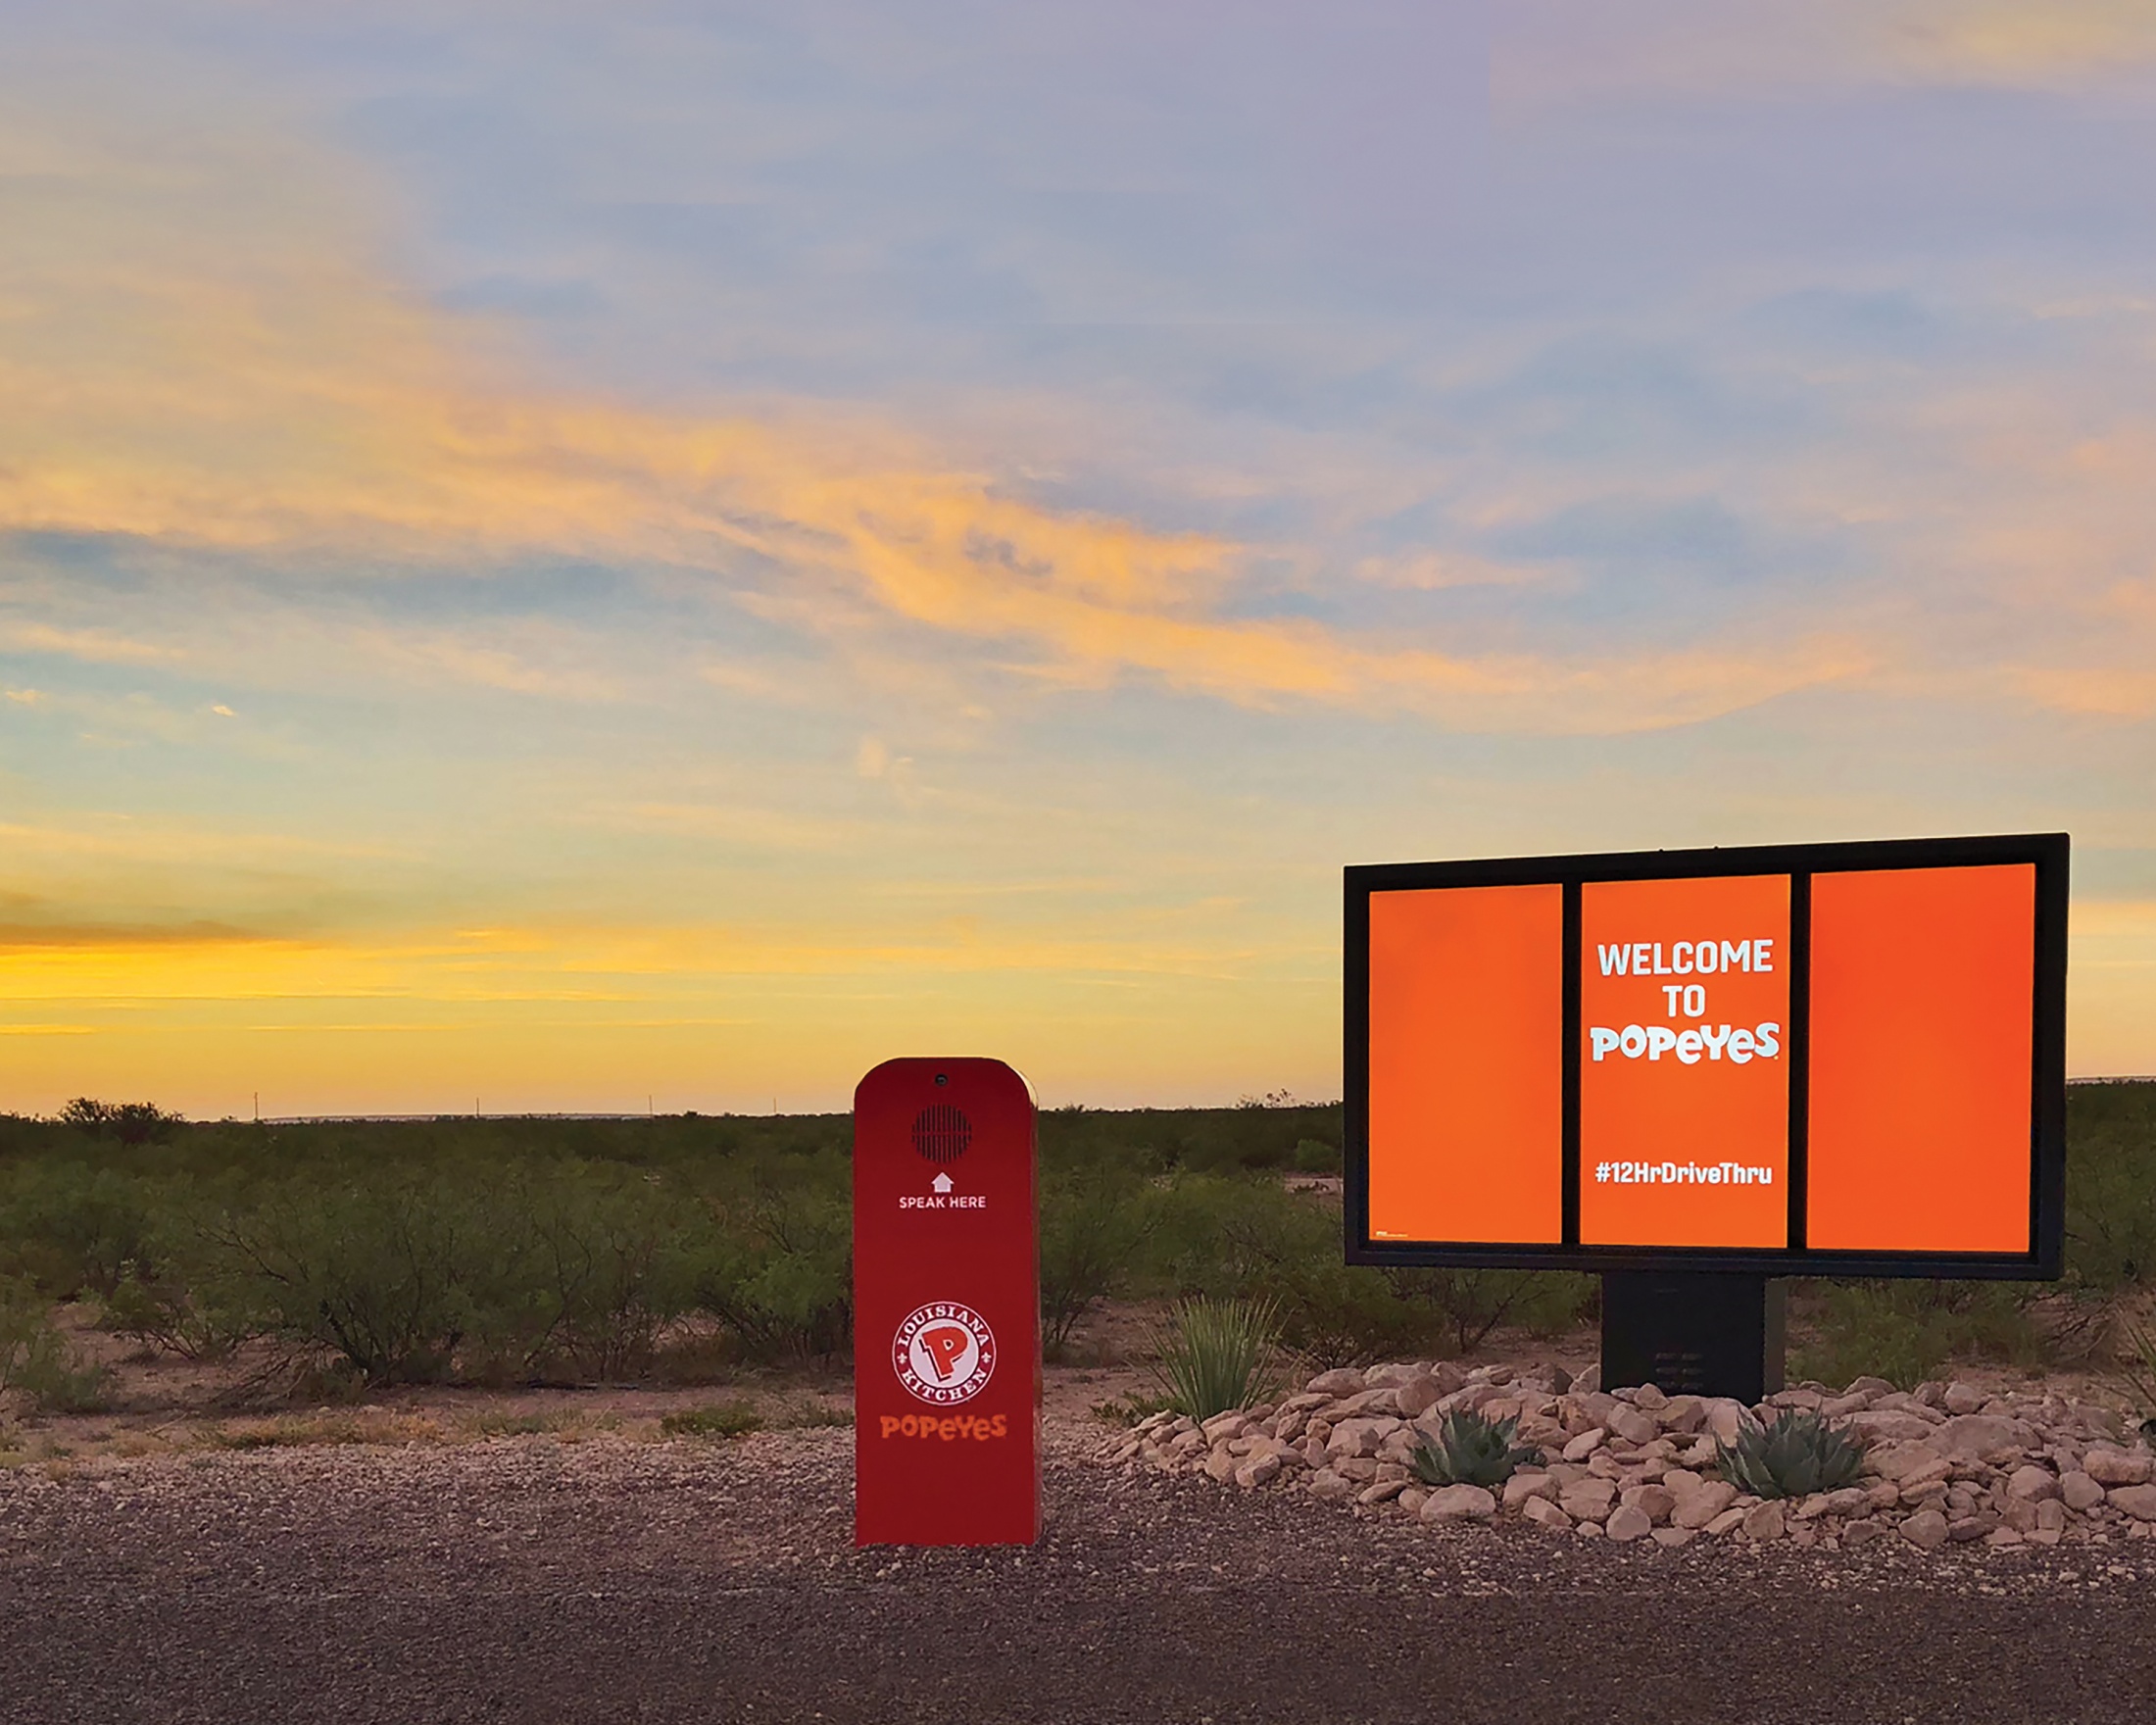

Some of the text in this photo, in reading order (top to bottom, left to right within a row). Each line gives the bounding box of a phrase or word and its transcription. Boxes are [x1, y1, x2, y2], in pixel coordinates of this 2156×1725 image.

[1597, 938, 1774, 976] WELCOME
[1662, 984, 1706, 1018] TO
[1594, 1160, 1773, 1185] #12HrDriveThru
[899, 1196, 987, 1208] SPEAK HERE
[897, 1305, 990, 1348] LOUISIANA
[920, 1325, 969, 1382] P
[902, 1368, 987, 1402] KITCHEN
